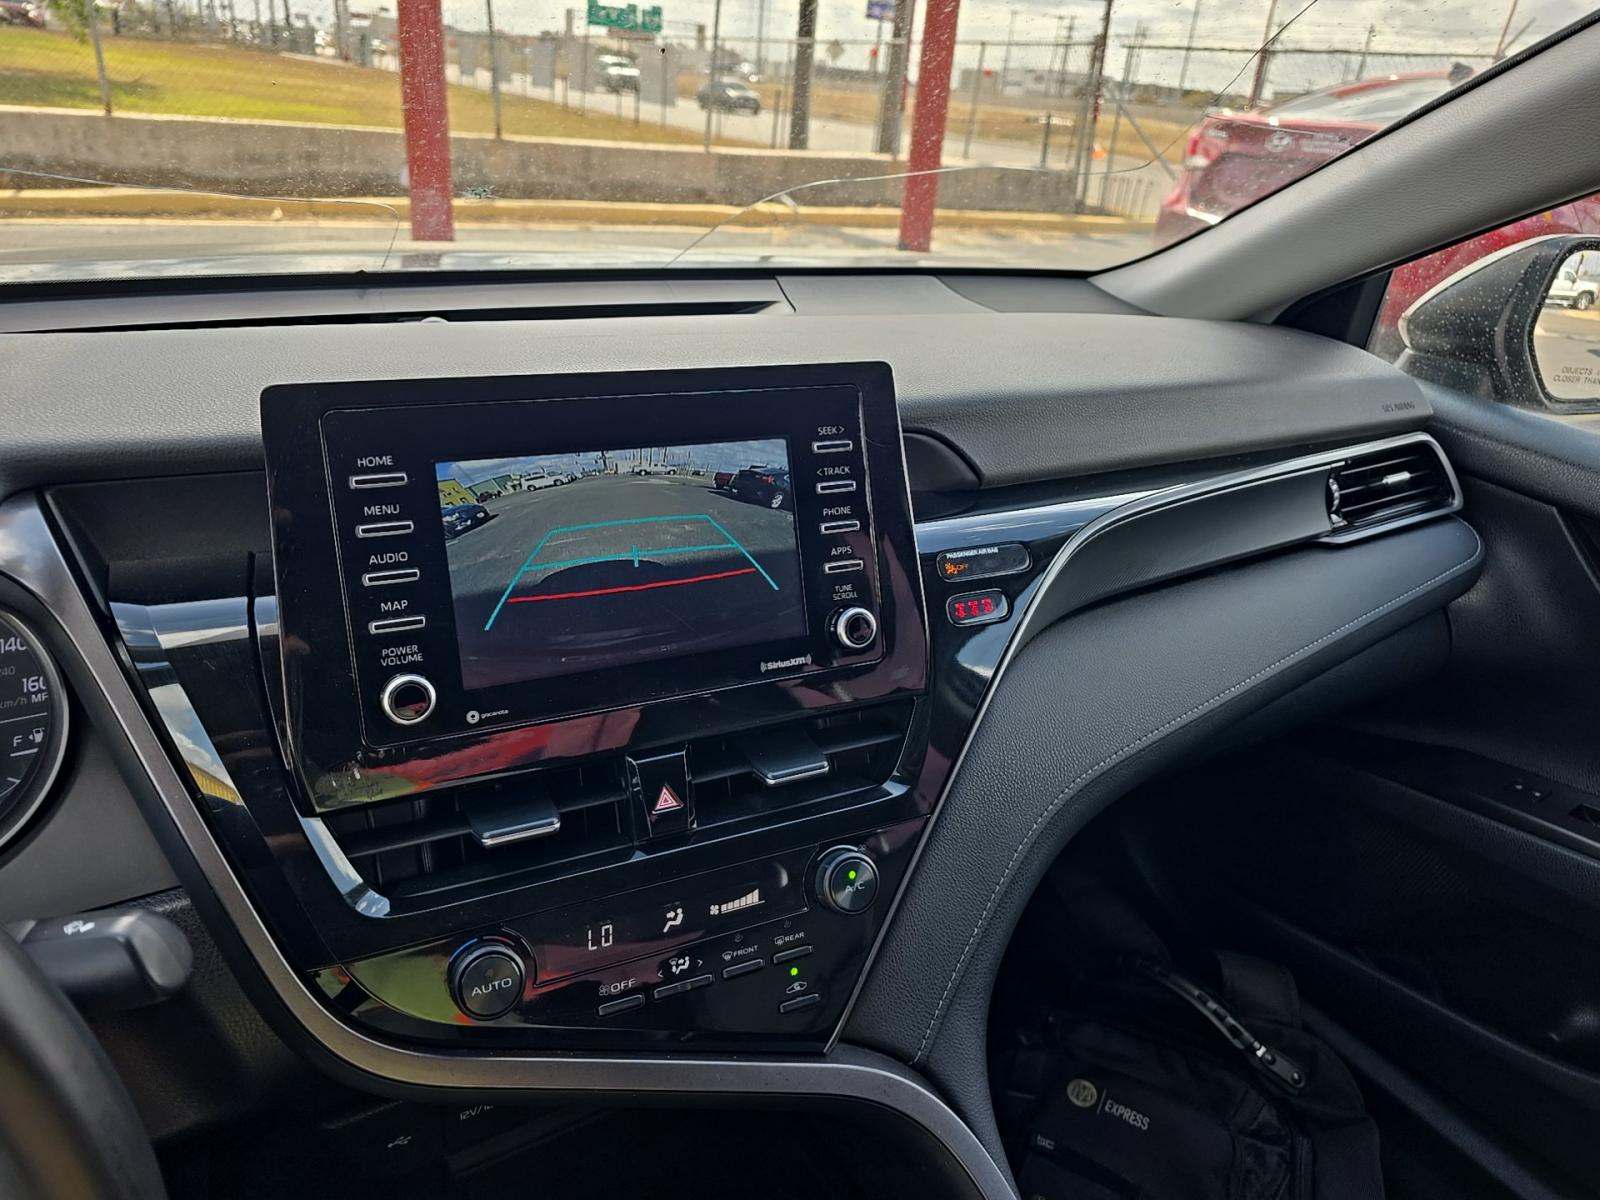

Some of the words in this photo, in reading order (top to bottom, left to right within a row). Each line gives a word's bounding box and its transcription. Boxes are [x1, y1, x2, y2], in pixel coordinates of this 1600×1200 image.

[1561, 366, 1593, 376] OBJECTS
[1553, 374, 1581, 383] CLOSER
[818, 427, 838, 435] SEEK
[357, 456, 393, 467] HOME
[823, 466, 850, 476] TRACK
[364, 504, 400, 516] MENU
[823, 506, 852, 516] PHONE
[831, 547, 852, 556] APPS
[369, 552, 408, 565] AUDIO
[835, 584, 853, 592] TUNE
[832, 591, 858, 601] SCROLL
[380, 600, 408, 612] MAP
[382, 645, 419, 657] POWER
[381, 652, 424, 667] VOLUME
[13, 735, 23, 747] F
[845, 881, 866, 893] A/C
[784, 932, 805, 943] REAR
[733, 945, 759, 958] FRONT
[471, 977, 513, 998] AUTO
[610, 978, 637, 993] OFF
[1104, 1099, 1150, 1131] EXPRESS
